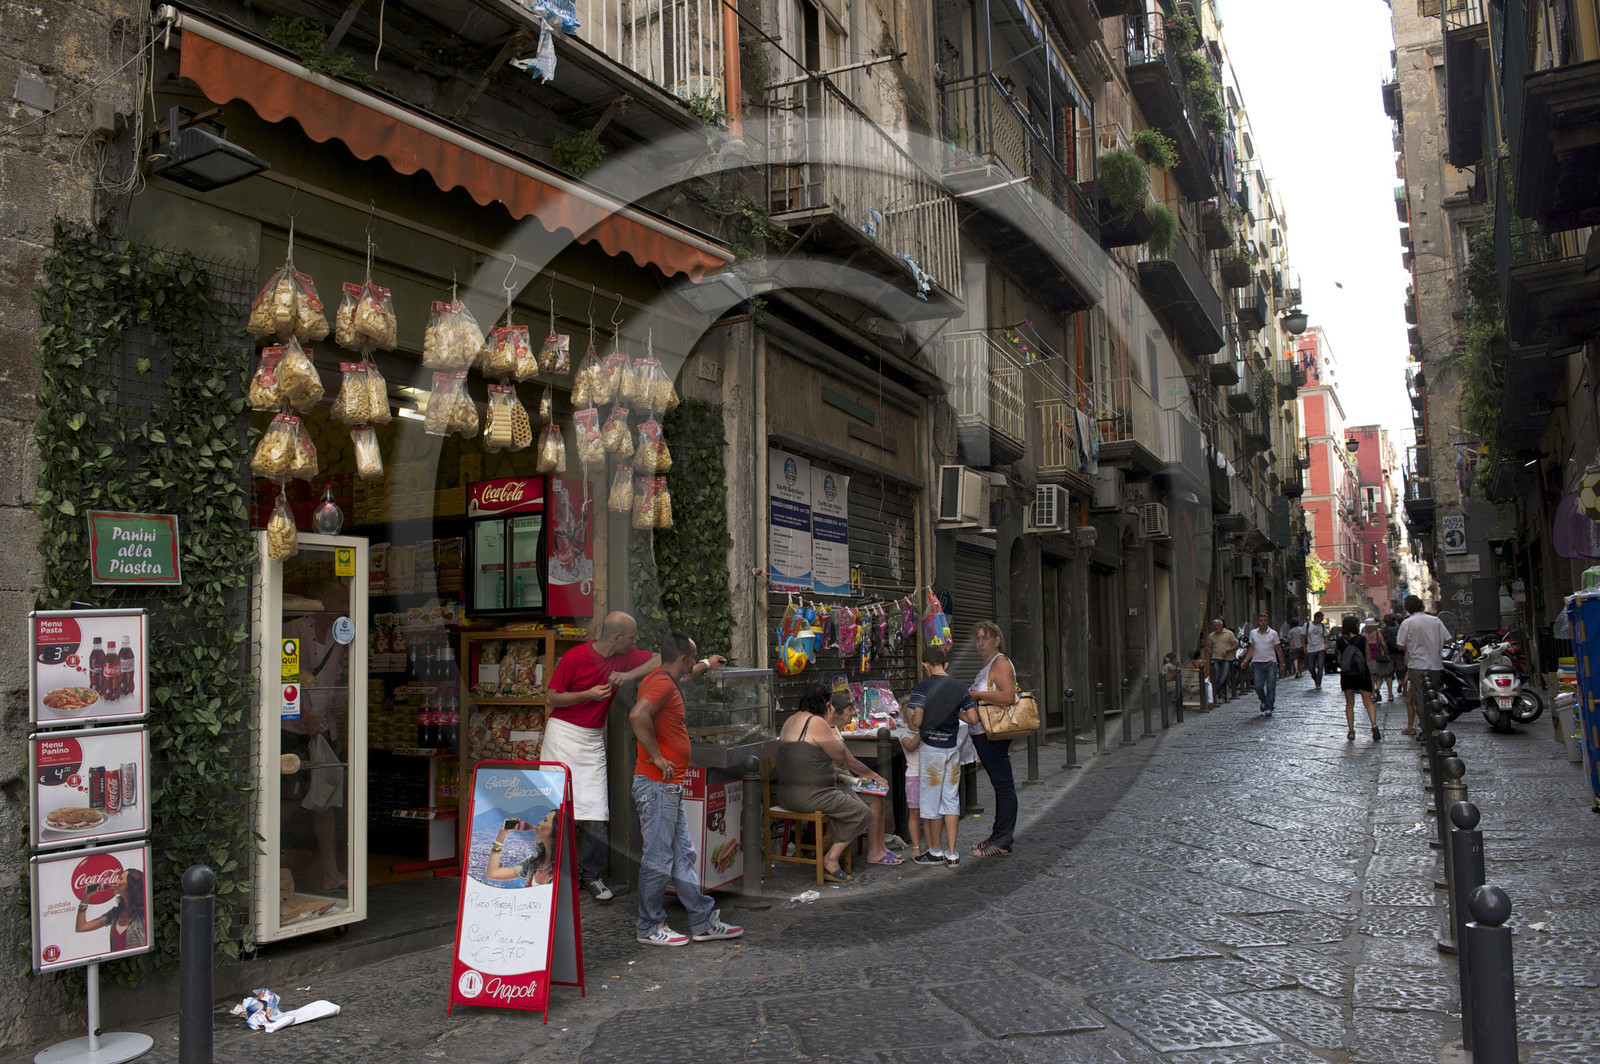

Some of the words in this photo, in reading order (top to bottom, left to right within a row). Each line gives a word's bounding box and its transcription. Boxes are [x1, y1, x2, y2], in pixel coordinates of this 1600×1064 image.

[481, 481, 527, 504] Coca-Cola
[112, 526, 156, 542] Panini
[118, 544, 152, 558] alla
[110, 559, 162, 574] Piastra
[684, 768, 700, 778] ichi
[484, 776, 520, 790] Gustala
[74, 868, 121, 890] Coca-Cola
[43, 906, 76, 917] ghiacciata
[47, 901, 71, 910] gustala
[486, 977, 537, 1003] Napoli
